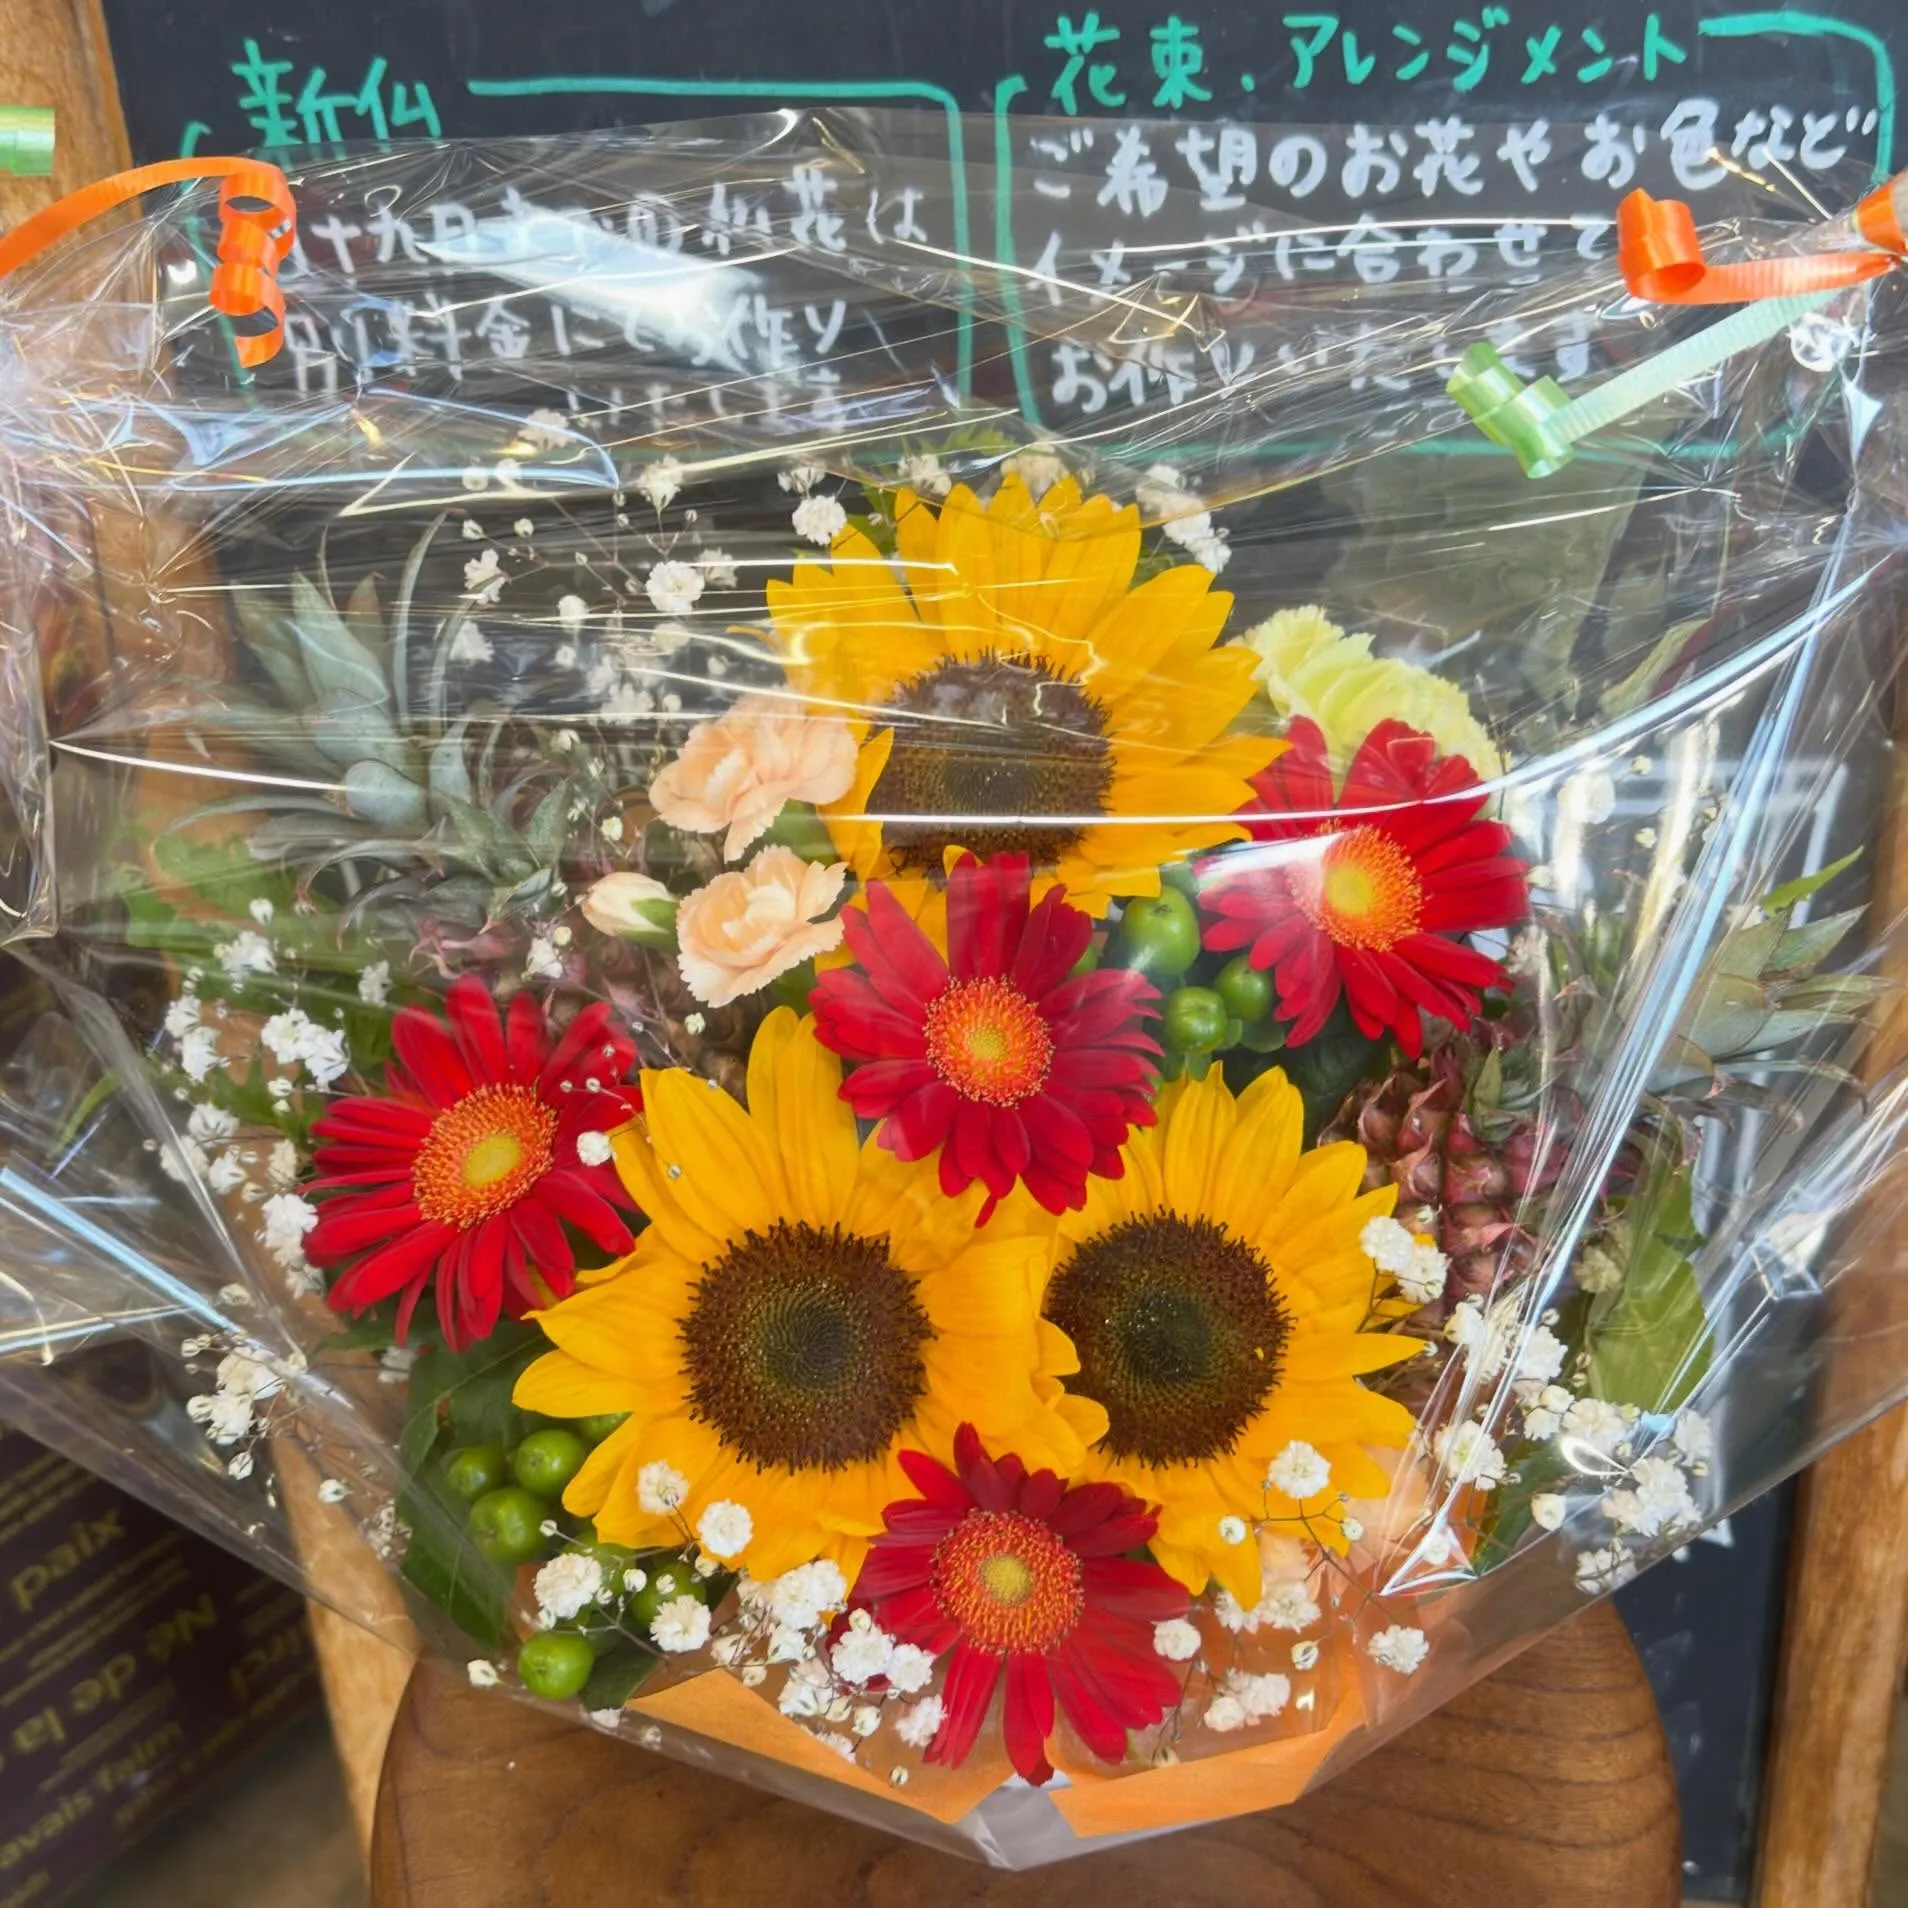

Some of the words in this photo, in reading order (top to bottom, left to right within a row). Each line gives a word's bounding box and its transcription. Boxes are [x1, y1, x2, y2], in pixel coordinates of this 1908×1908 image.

[1030, 98, 1878, 217] ご希望のお花やお色など
[1030, 212, 1610, 306] イメージに合わせて
[10, 1508, 126, 1613] paix
[12, 1706, 66, 1753] la
[69, 1653, 136, 1714] de
